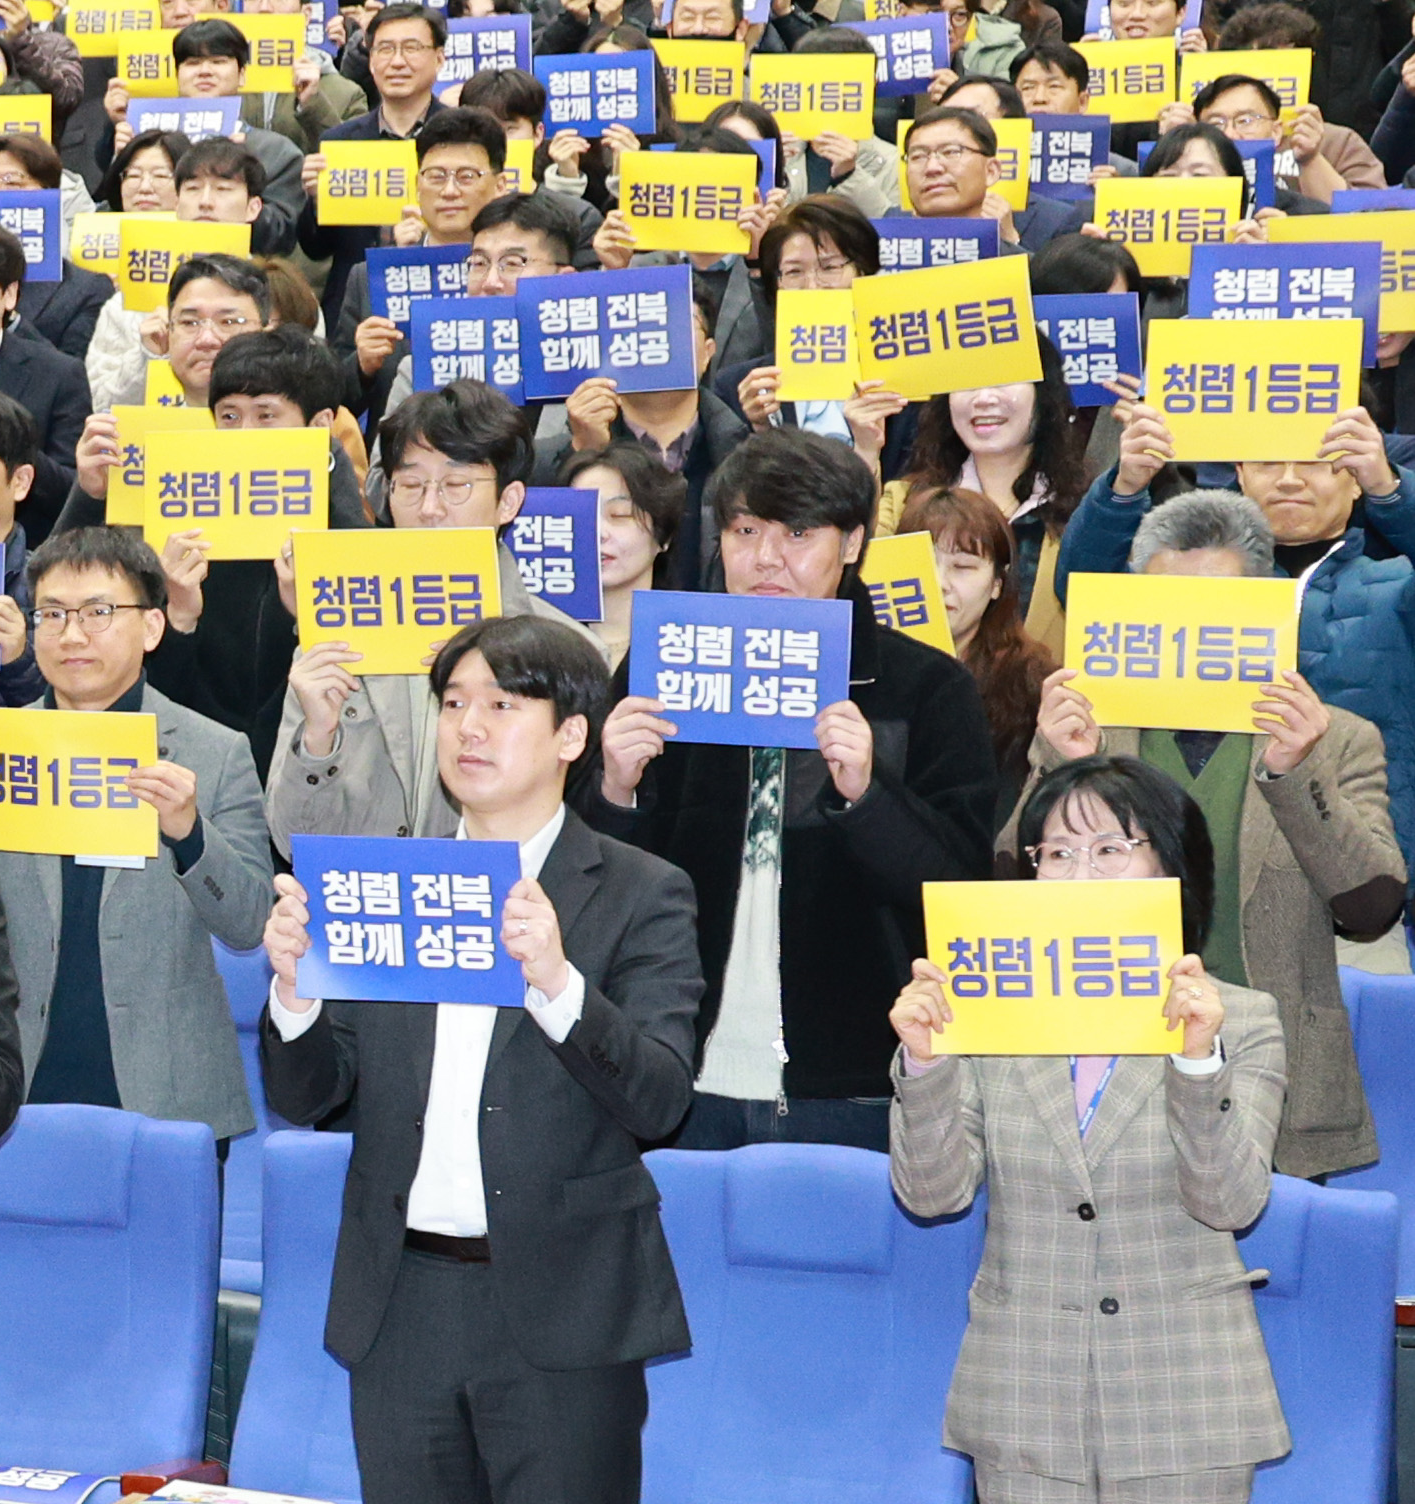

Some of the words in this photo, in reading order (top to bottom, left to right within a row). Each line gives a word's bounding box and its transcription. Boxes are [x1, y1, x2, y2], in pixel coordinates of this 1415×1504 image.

[549, 71, 590, 95] 청렴
[596, 68, 637, 93] 전북
[550, 97, 591, 122] 함께
[597, 95, 637, 119] 성공
[630, 183, 742, 220] 청렴1등급
[1214, 269, 1278, 302] 청렴
[1289, 268, 1354, 302] 전북
[539, 297, 597, 333] 청렴
[608, 292, 667, 328] 전북
[870, 298, 1019, 360] 청렴1등급
[541, 335, 600, 371] 함께
[609, 331, 669, 366] 성공
[1163, 364, 1340, 413] 청렴1등급
[159, 470, 312, 517] 청렴1등급
[313, 575, 486, 628] 청렴1등급
[659, 623, 732, 666] 청렴
[745, 629, 819, 670] 전북
[1083, 622, 1275, 682] 청렴1등급
[657, 670, 731, 712] 함께
[743, 671, 817, 717] 성공
[323, 871, 400, 915] 청렴
[412, 874, 491, 917] 전북
[325, 921, 404, 966] 함께
[416, 919, 494, 969] 성공
[948, 936, 1159, 997] 청렴1등급
